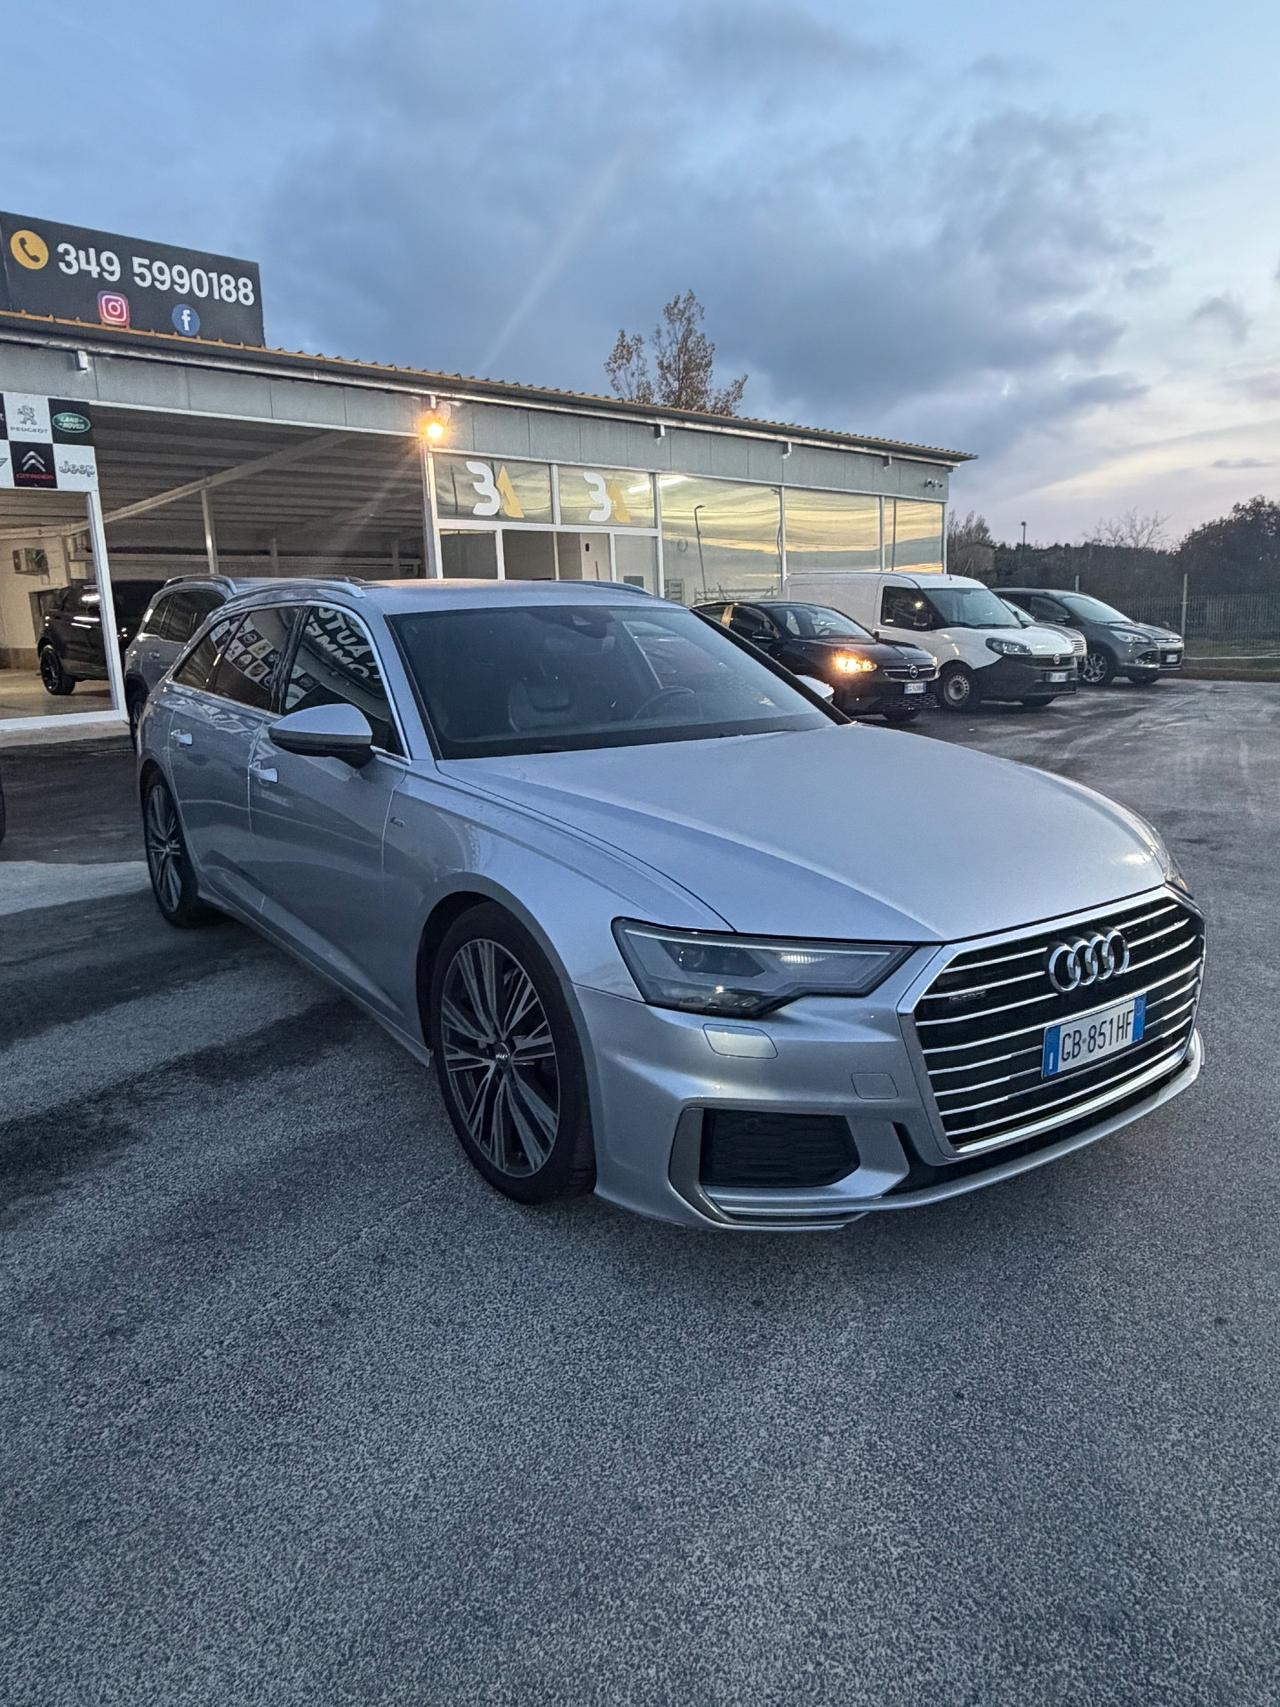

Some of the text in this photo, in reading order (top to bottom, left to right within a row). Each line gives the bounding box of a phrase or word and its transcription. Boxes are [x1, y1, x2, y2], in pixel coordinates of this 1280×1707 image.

[56, 242, 255, 306] 349 5990188
[59, 461, 96, 478] Jeep
